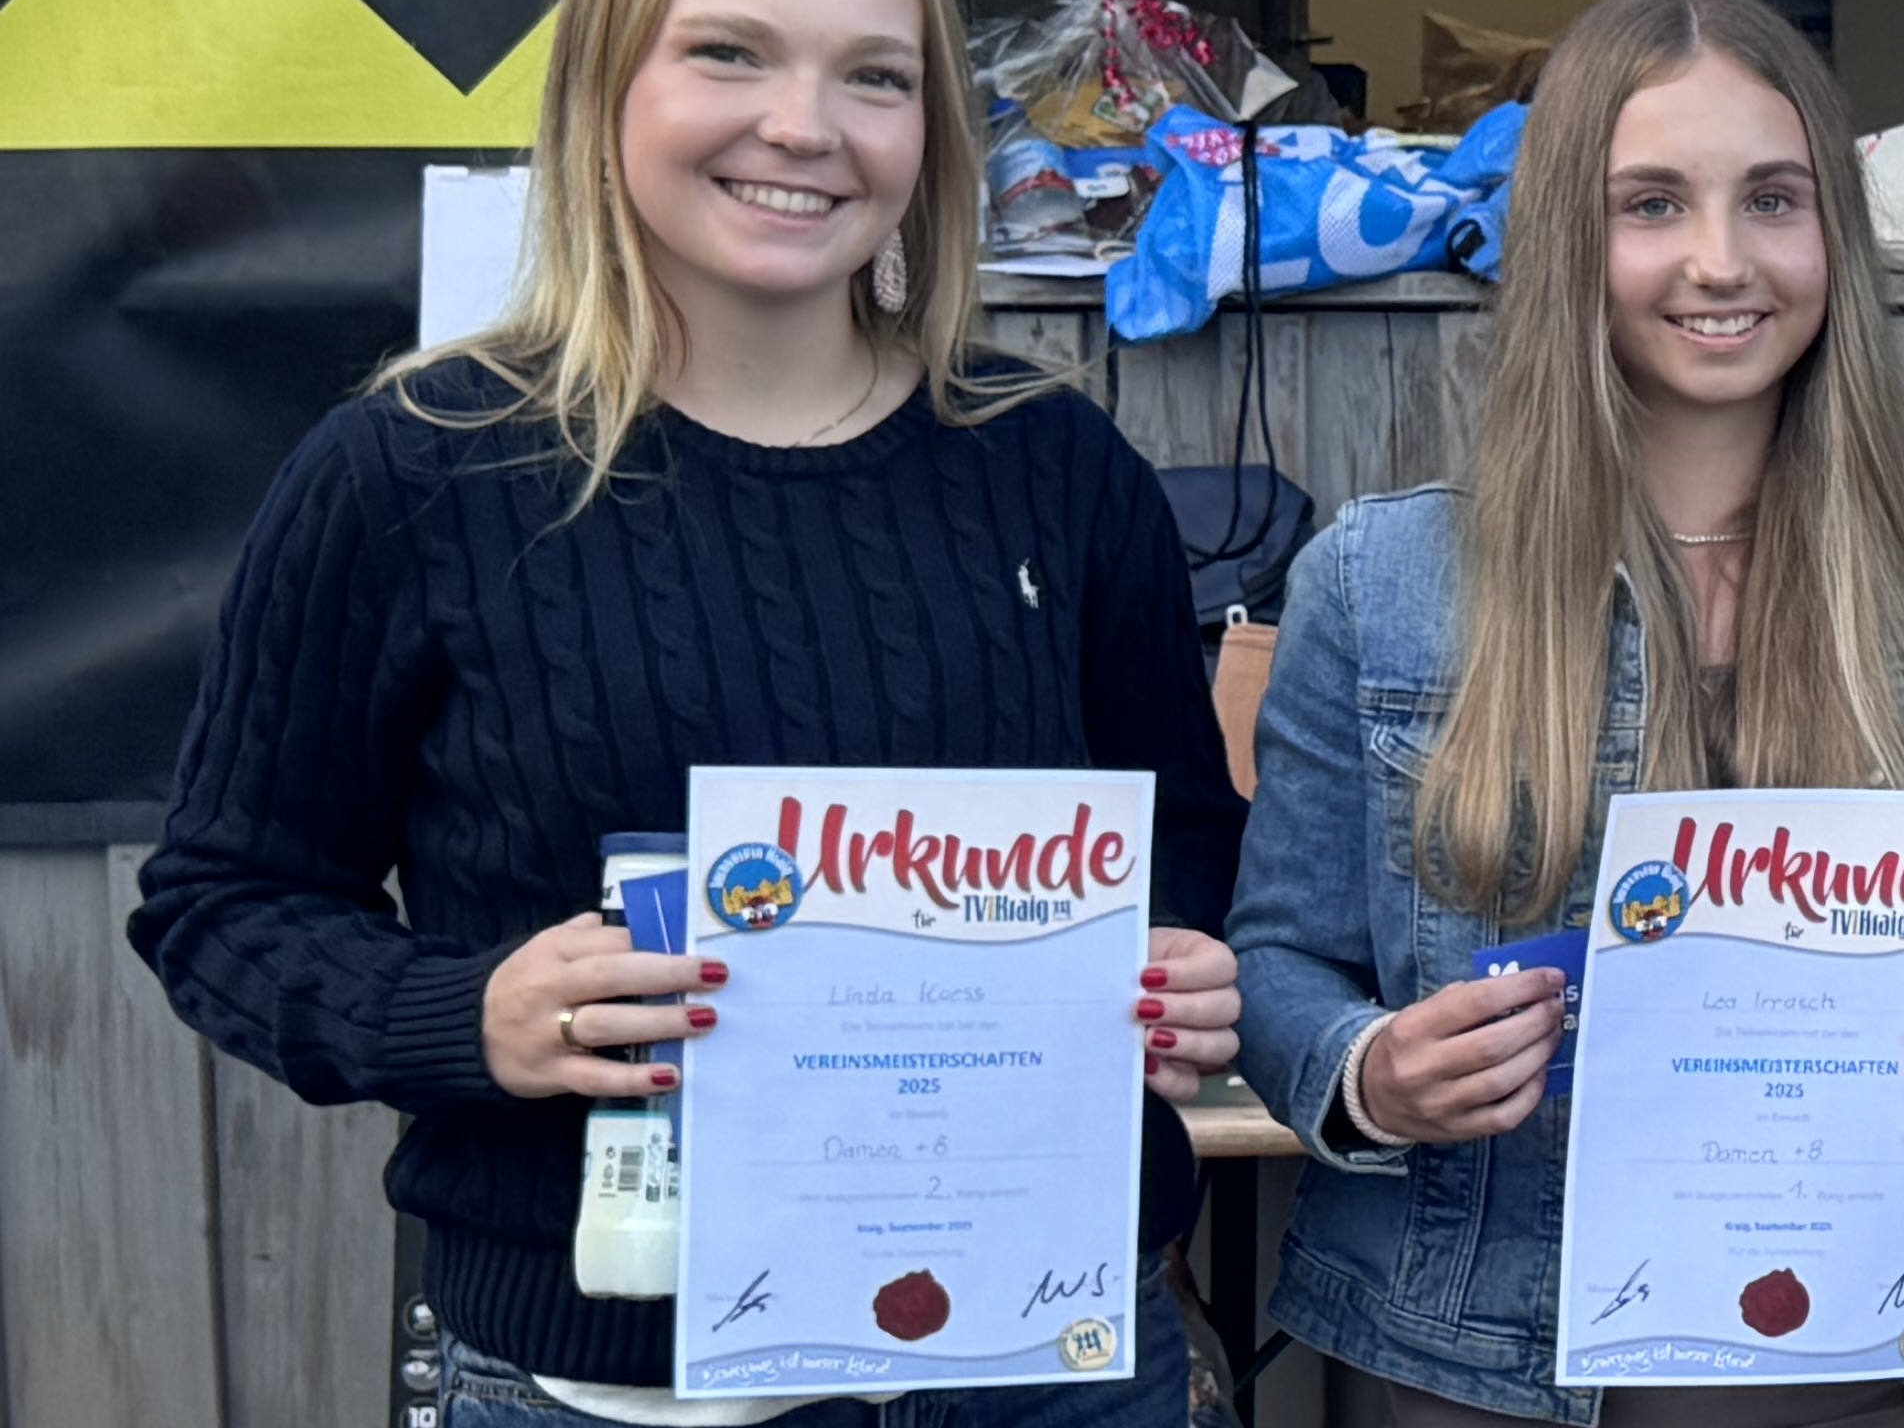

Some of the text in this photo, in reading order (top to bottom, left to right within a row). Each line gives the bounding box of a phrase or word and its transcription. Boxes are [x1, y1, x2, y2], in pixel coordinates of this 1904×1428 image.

[777, 795, 1137, 911] Urkunde
[793, 1051, 1043, 1070] VEREINSMEISTERSCHAFTEN
[1671, 1057, 1900, 1076] VEREINSMEISTERSCHAFTEN
[898, 1078, 941, 1095] 2025
[1764, 1083, 1804, 1098] 2025
[824, 1134, 901, 1162] Damen
[1702, 1140, 1778, 1164] Damen
